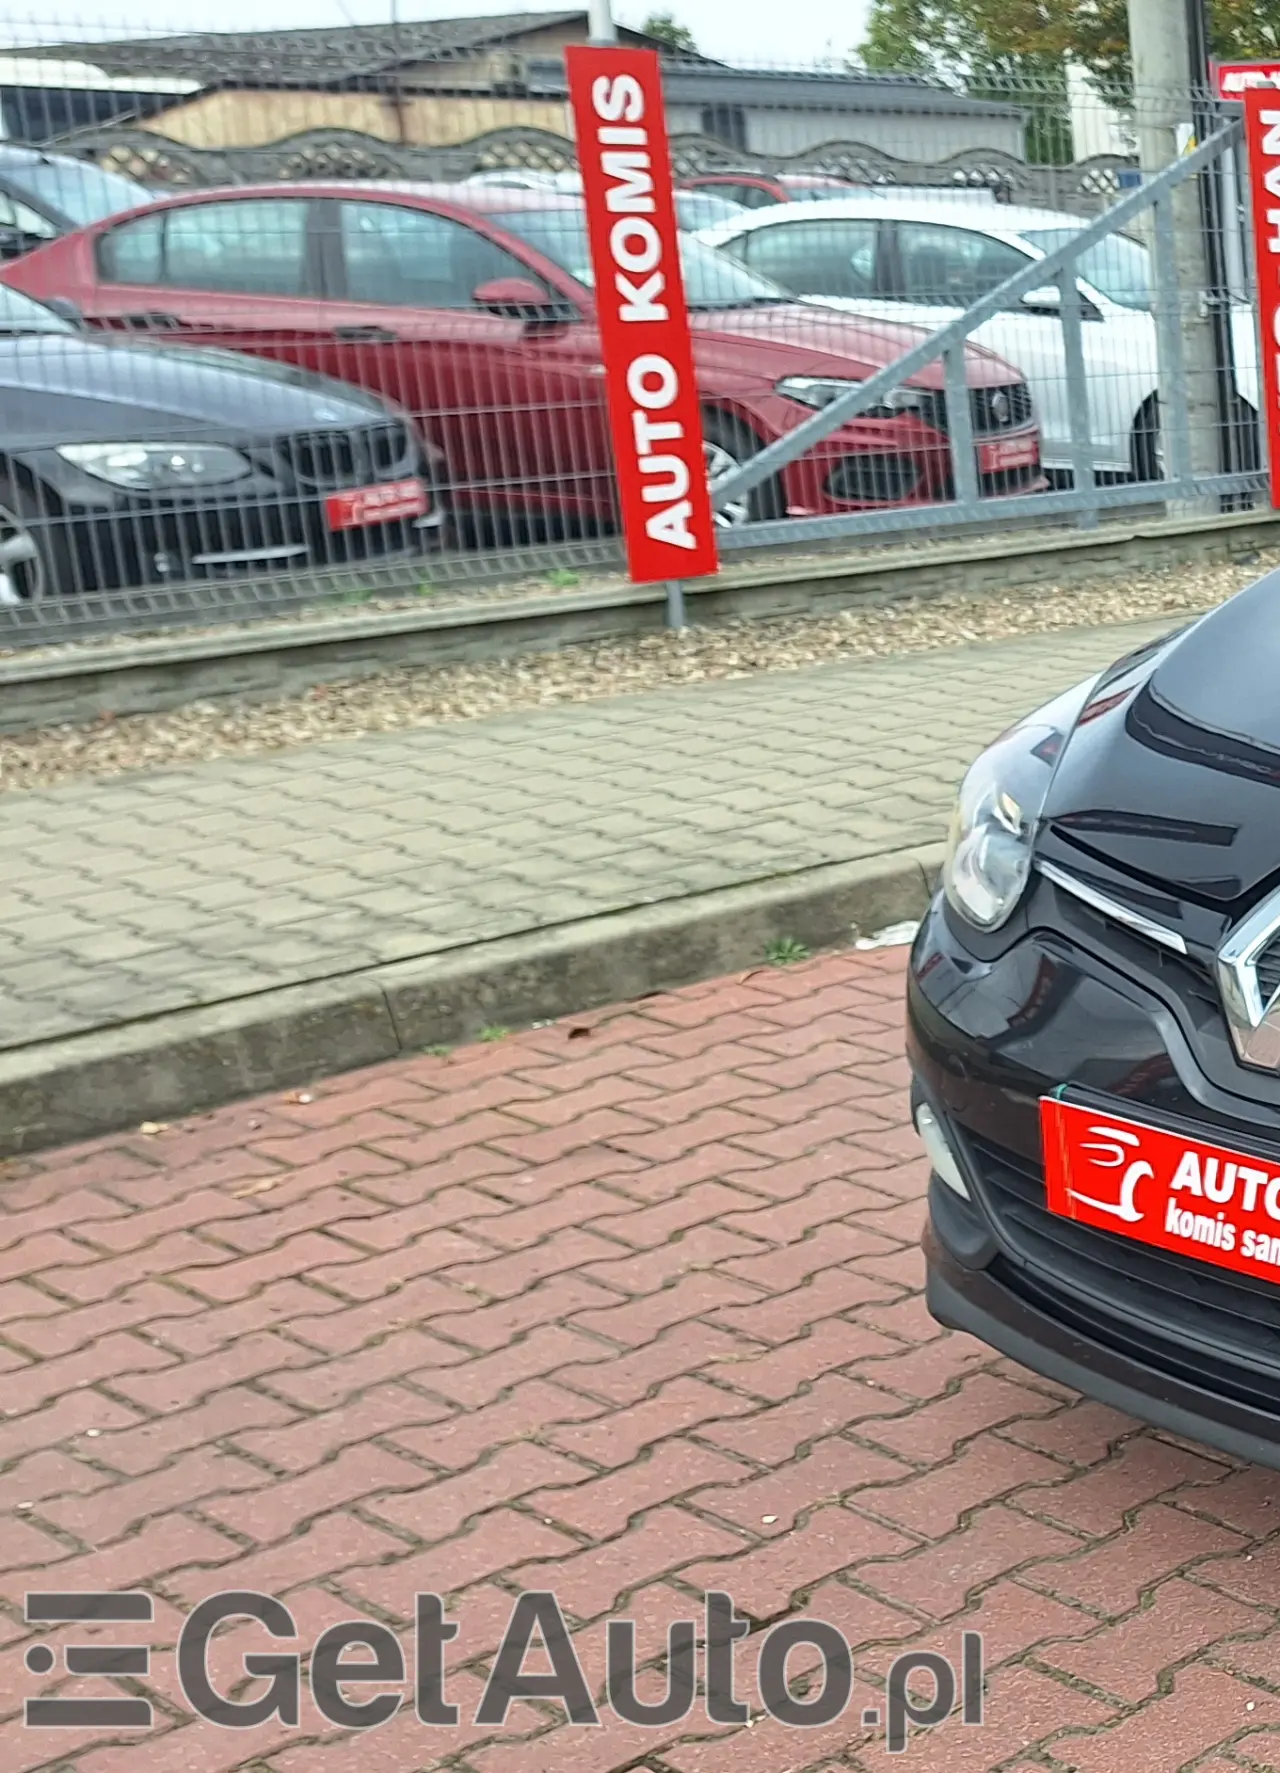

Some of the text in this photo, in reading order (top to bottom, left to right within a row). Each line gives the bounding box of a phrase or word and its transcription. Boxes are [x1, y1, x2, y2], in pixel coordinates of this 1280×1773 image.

[592, 74, 697, 550] AUTO KOMIS
[1163, 1196, 1237, 1252] komis
